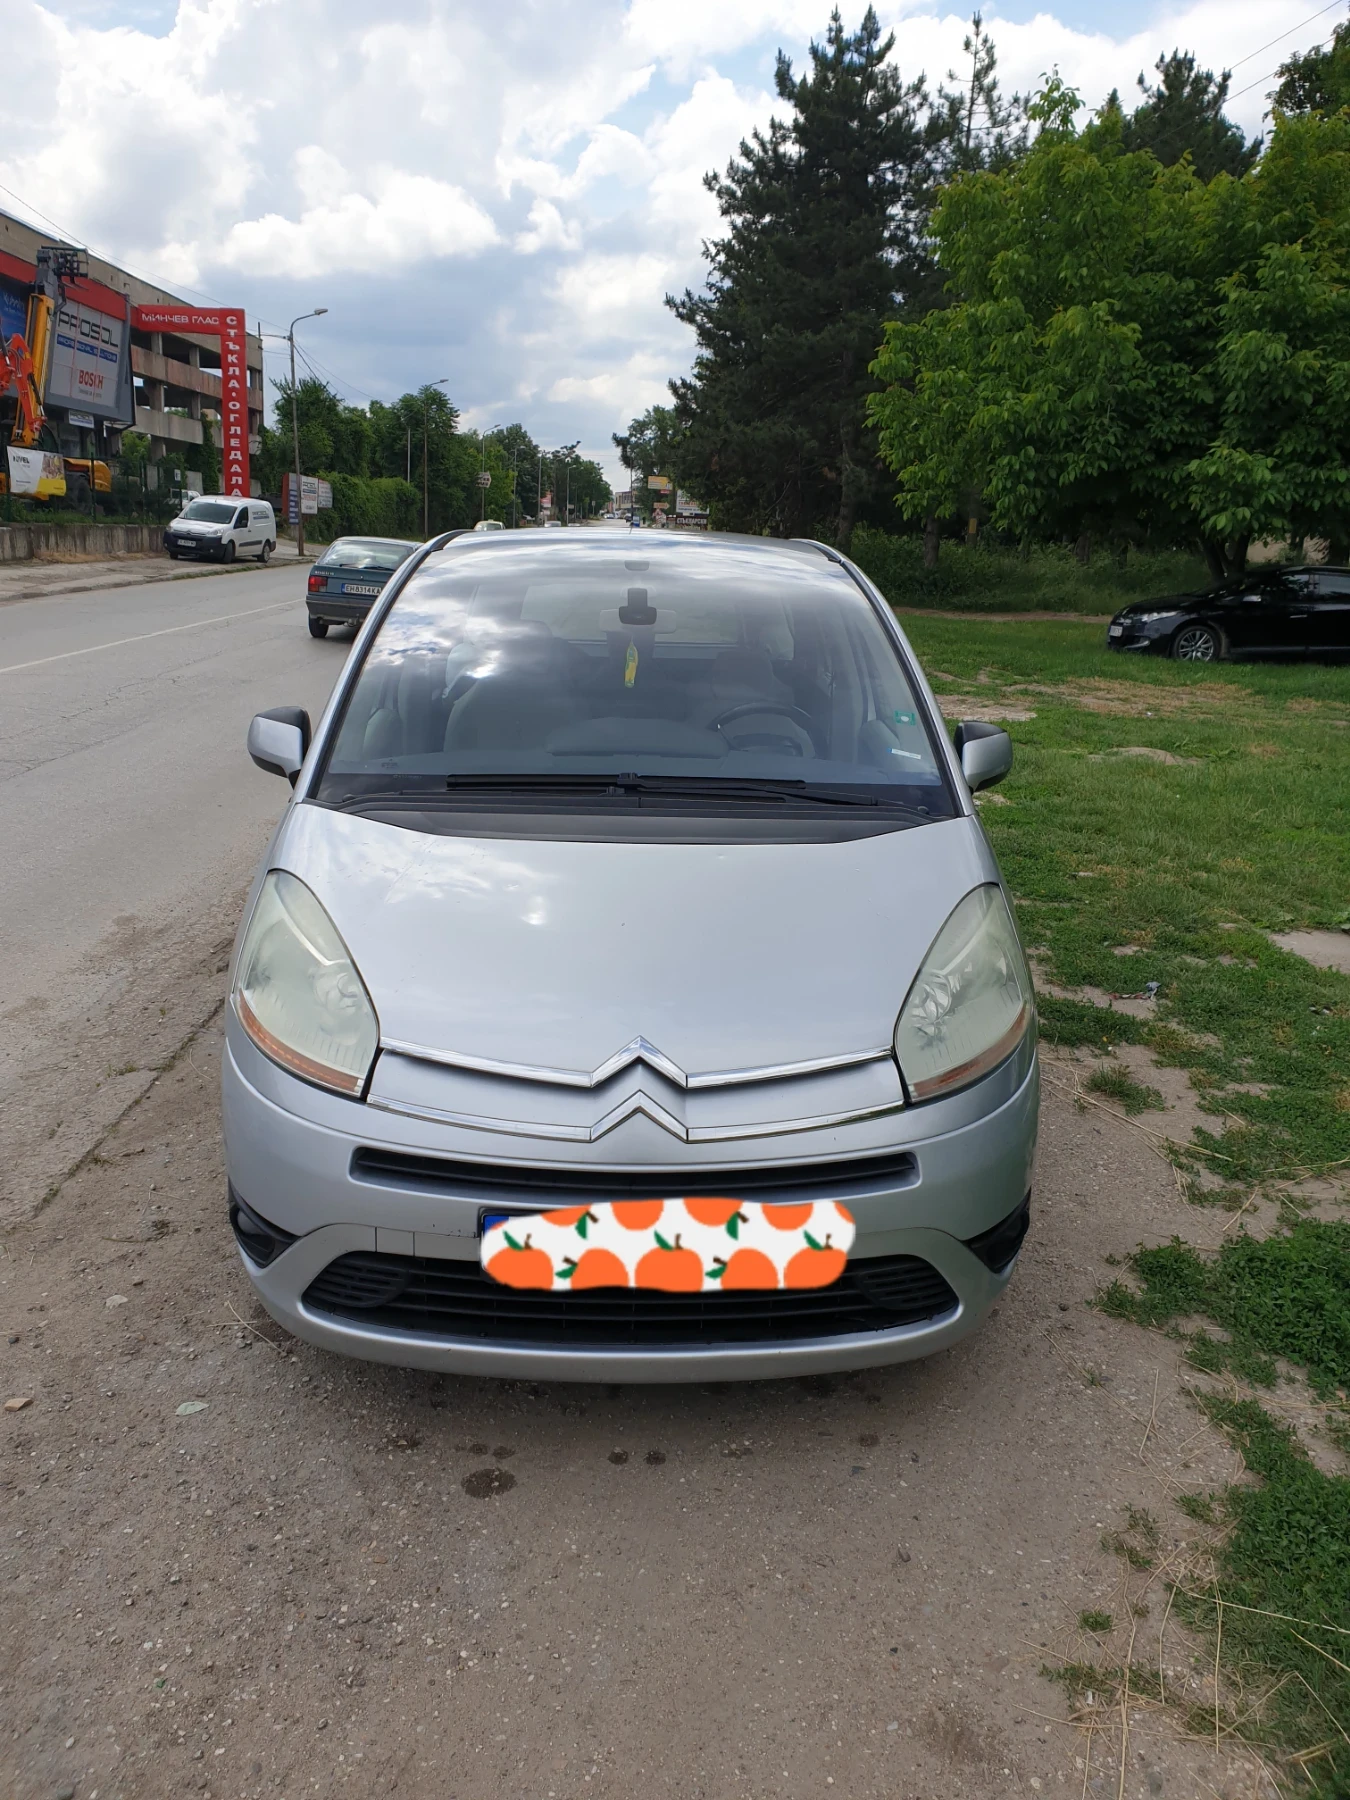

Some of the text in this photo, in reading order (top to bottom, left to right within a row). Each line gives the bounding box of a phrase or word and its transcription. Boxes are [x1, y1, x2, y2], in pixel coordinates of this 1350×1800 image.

[141, 313, 220, 325] МИНЧЕВ ГЛАС
[225, 316, 243, 497] СТЪКЛА ОГЛЕДАЛА
